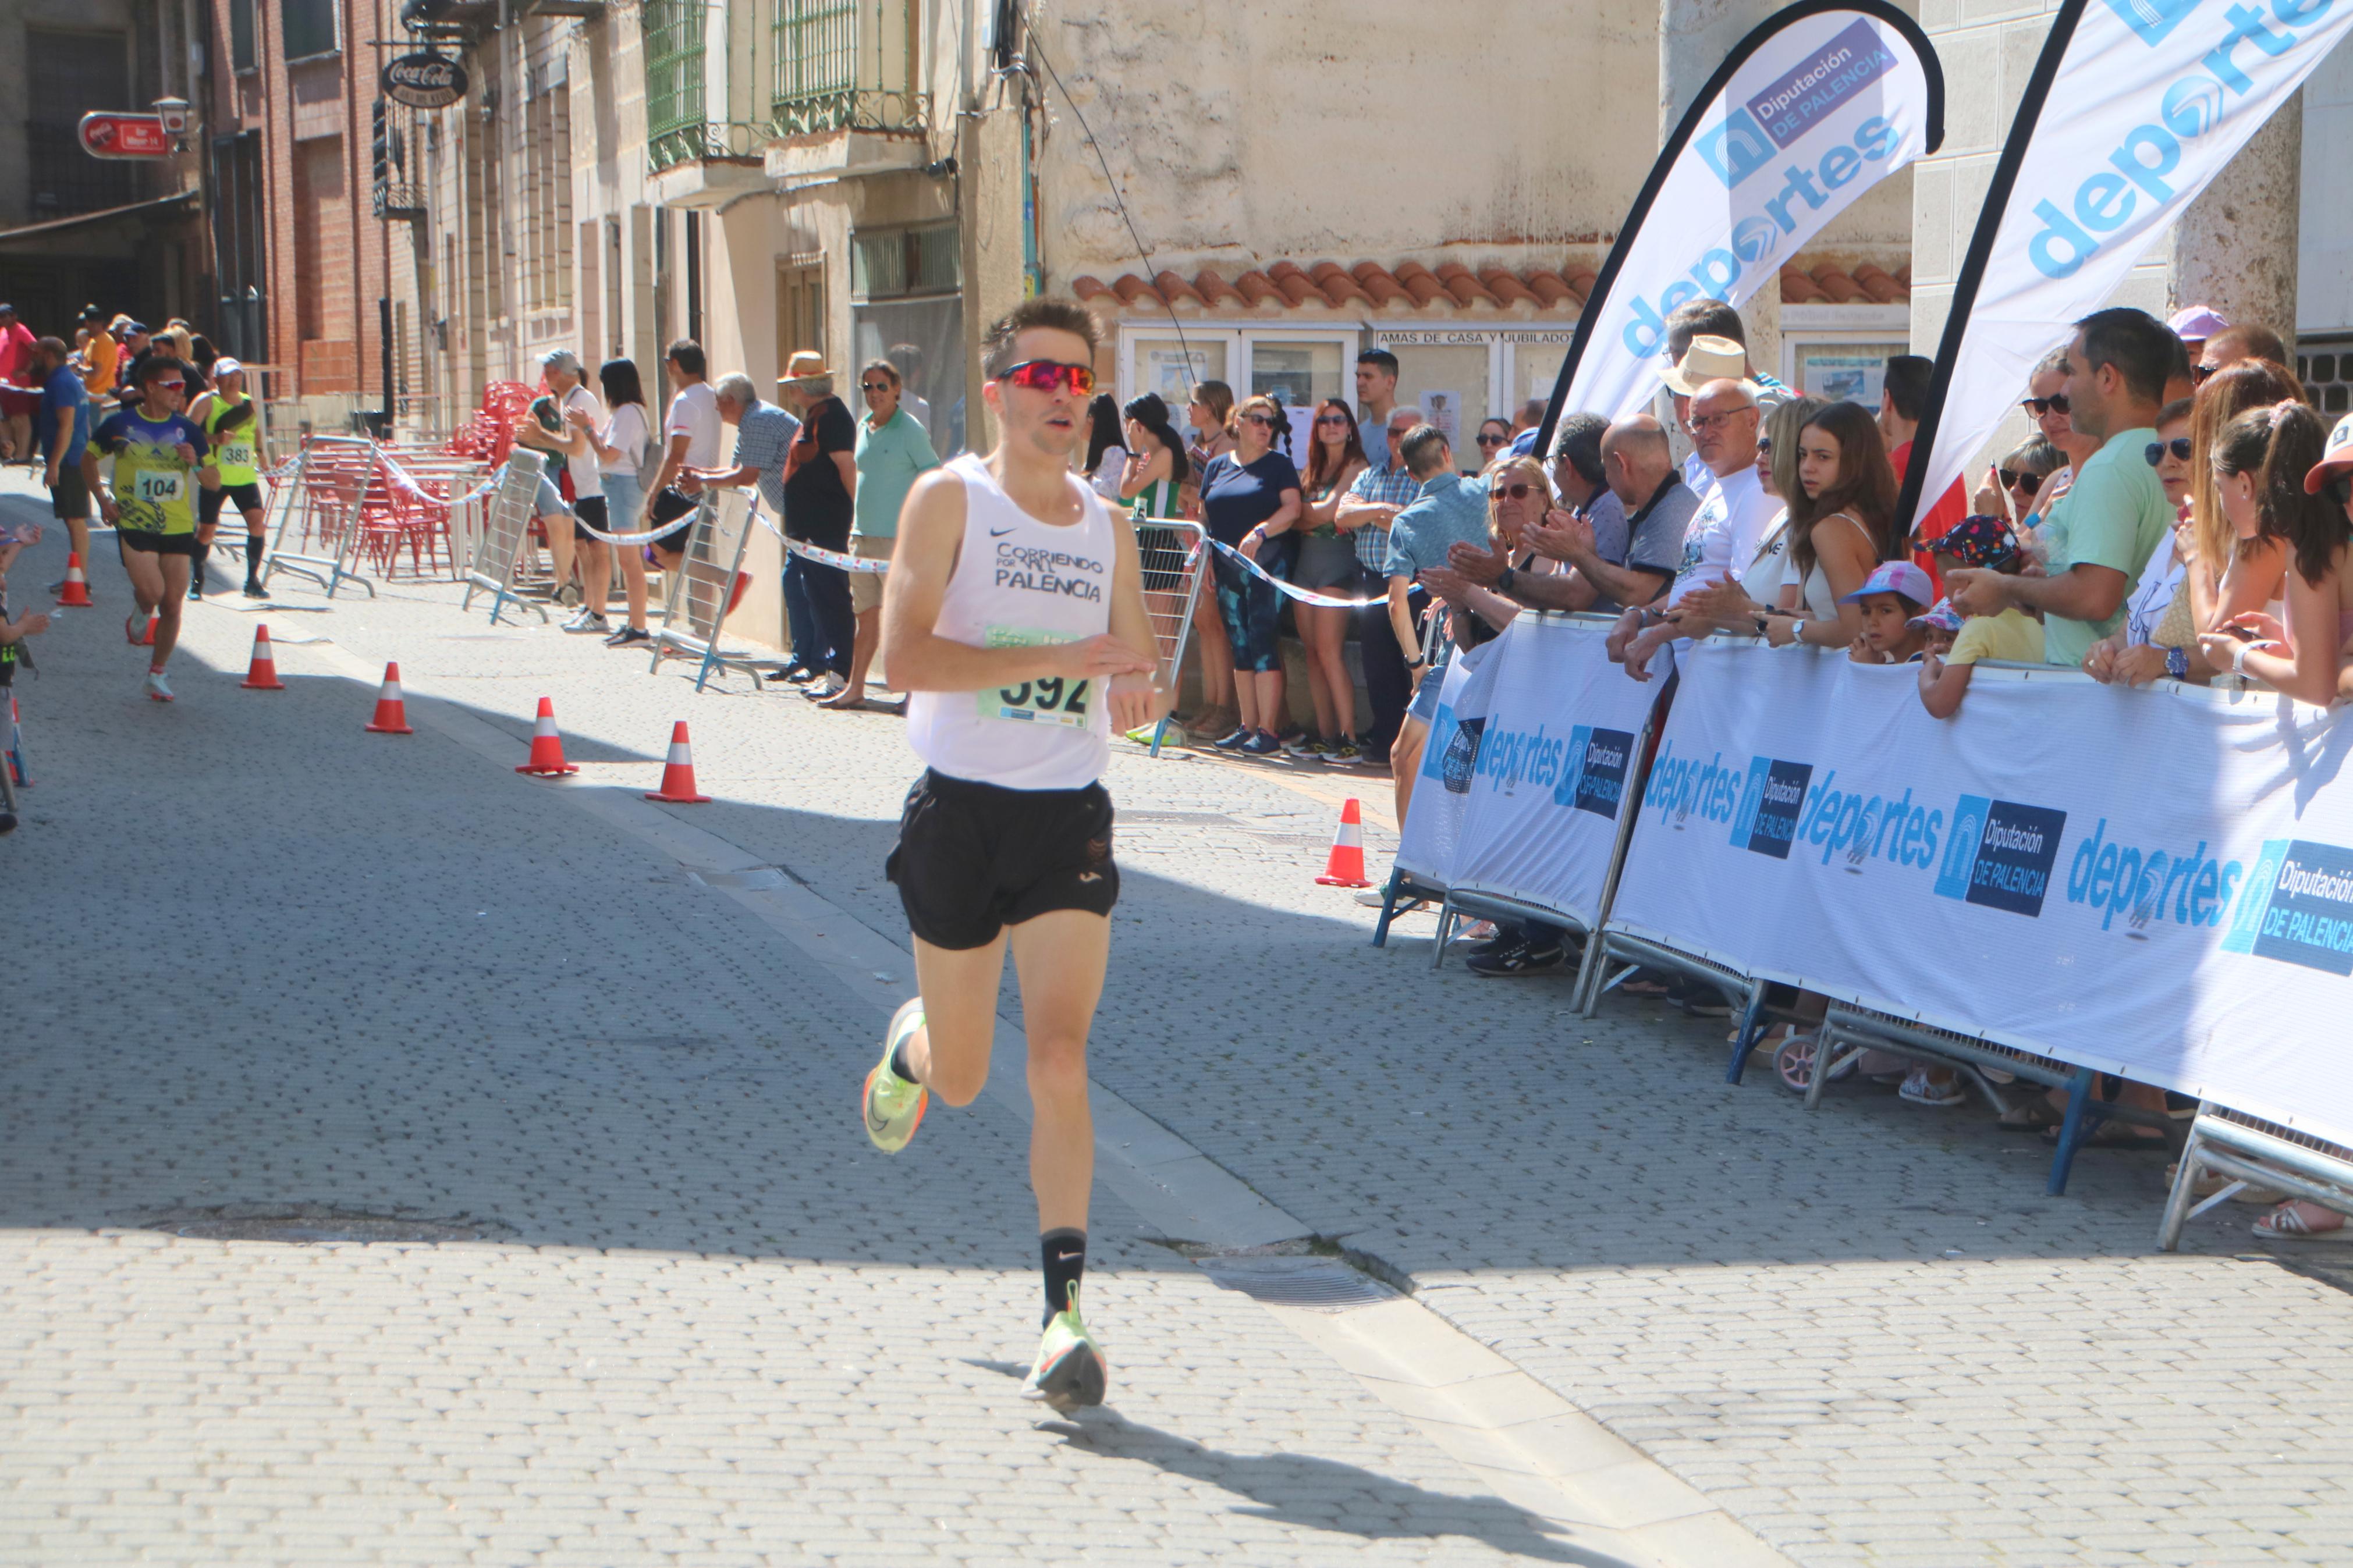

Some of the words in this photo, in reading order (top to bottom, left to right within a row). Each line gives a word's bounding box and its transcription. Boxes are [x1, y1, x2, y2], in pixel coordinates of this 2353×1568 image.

[1757, 46, 1852, 120] Diputación
[1772, 112, 1801, 139] DE
[1799, 49, 1889, 118] PALENCIA
[1623, 116, 1899, 360] deportes
[1380, 333, 1417, 343] AMAS
[1424, 333, 1441, 343] DE
[1447, 333, 1484, 343] CASA
[1489, 333, 1496, 342] Y
[1504, 333, 1574, 343] JUBILADO
[226, 448, 249, 463] 383
[143, 478, 177, 496] 104
[996, 558, 1016, 567] POR
[997, 542, 1104, 574] CORRIENDO
[996, 569, 1101, 603] PALENCIA
[1475, 713, 1562, 792] deportes
[1588, 742, 1623, 769] Diputación
[1645, 740, 1741, 826] deportes
[1764, 776, 1801, 805] Diputación
[1754, 813, 1767, 835] DE
[1798, 770, 1943, 869] deportes
[1985, 818, 2043, 854] Diputación
[1974, 859, 1994, 886] DE
[1989, 863, 2046, 898] PALENCIA
[2067, 817, 2242, 931] deportes
[2279, 859, 2353, 903] Diputación
[2262, 906, 2291, 937] DE
